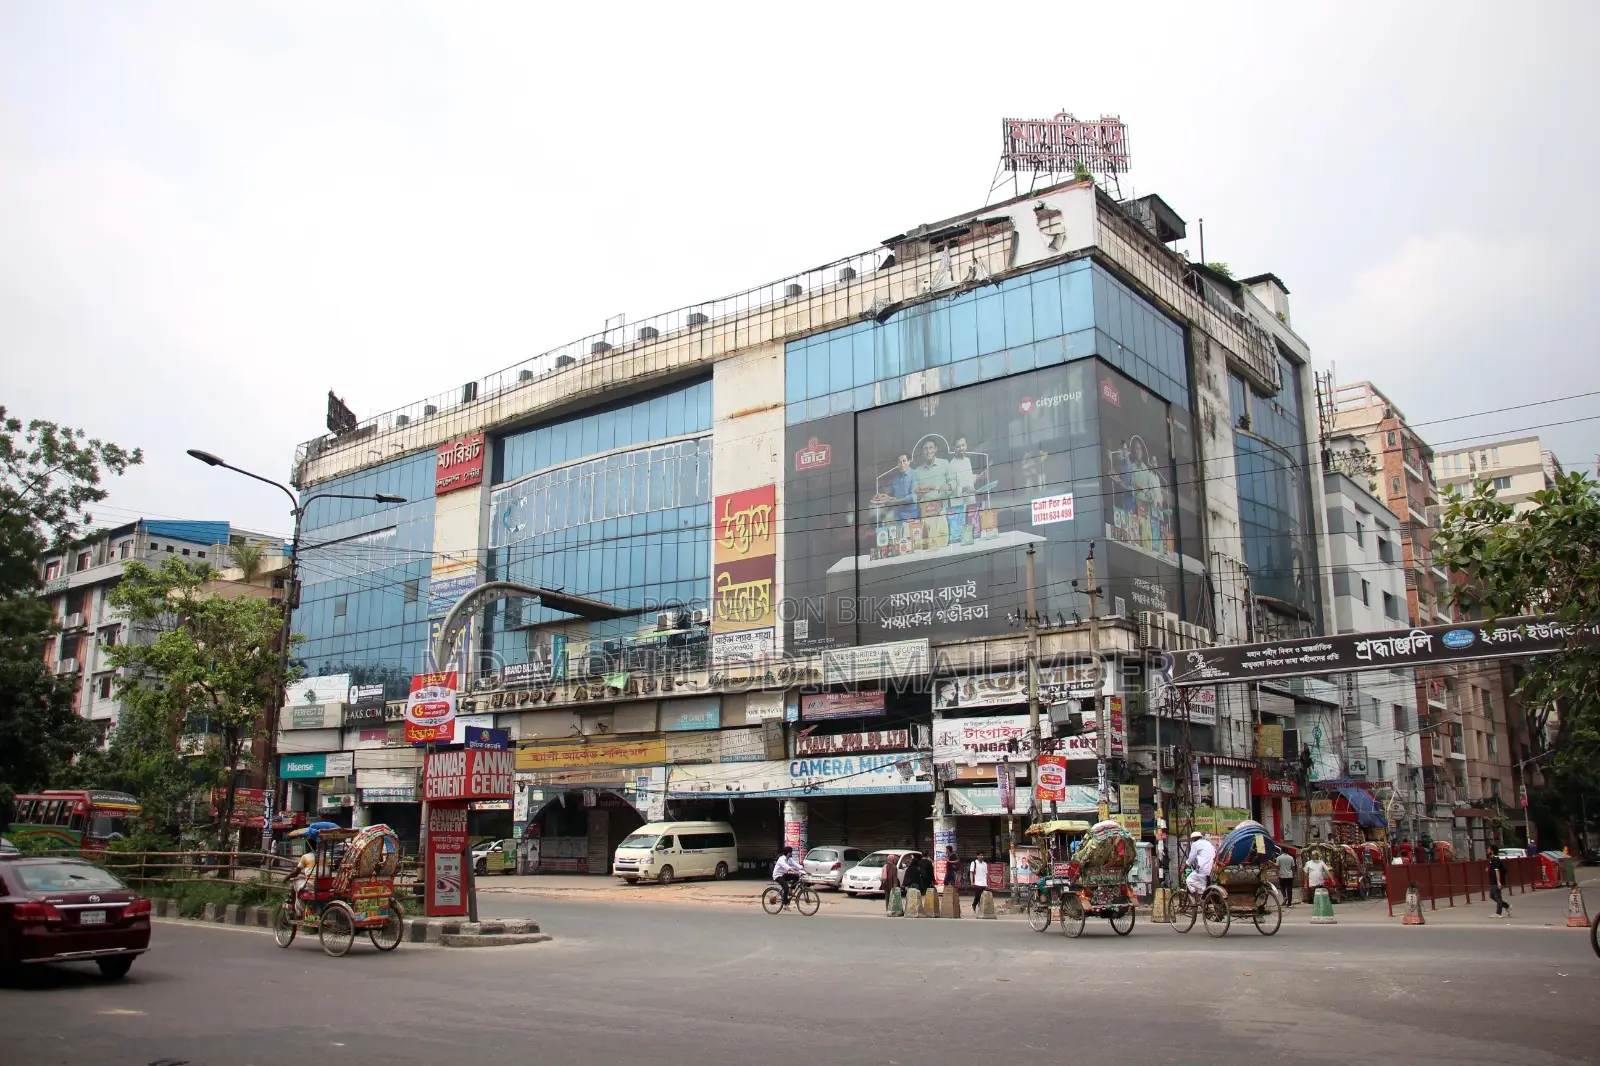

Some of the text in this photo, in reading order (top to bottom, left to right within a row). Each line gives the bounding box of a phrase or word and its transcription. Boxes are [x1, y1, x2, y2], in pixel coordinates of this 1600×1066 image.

[1035, 390, 1082, 408] citygroup
[437, 439, 482, 469] ম্যারিয়ট
[800, 450, 827, 465] তীর
[1033, 497, 1072, 511] Call For Ad
[889, 580, 977, 607] মমতায় বাড়াই
[936, 603, 989, 624] গভীরতা
[1353, 629, 1434, 662] শ্রদ্ধাঞ্জলি
[504, 661, 544, 676] BRAND BAZAAR
[490, 691, 556, 708] HAPPY
[294, 707, 324, 717] PERFECT 32
[408, 726, 436, 741] উদ্ভাস
[796, 735, 837, 749] TRAVEL
[841, 732, 862, 746] ZOO
[888, 730, 906, 745] LTD
[963, 726, 1025, 740] টাংগাইল
[287, 762, 314, 771] Hisense
[427, 752, 466, 778] ANWAR
[789, 757, 854, 778] CAMERA
[426, 775, 466, 798] CEMENT
[430, 808, 467, 822] ANWAR
[430, 821, 467, 832] CEMENT
